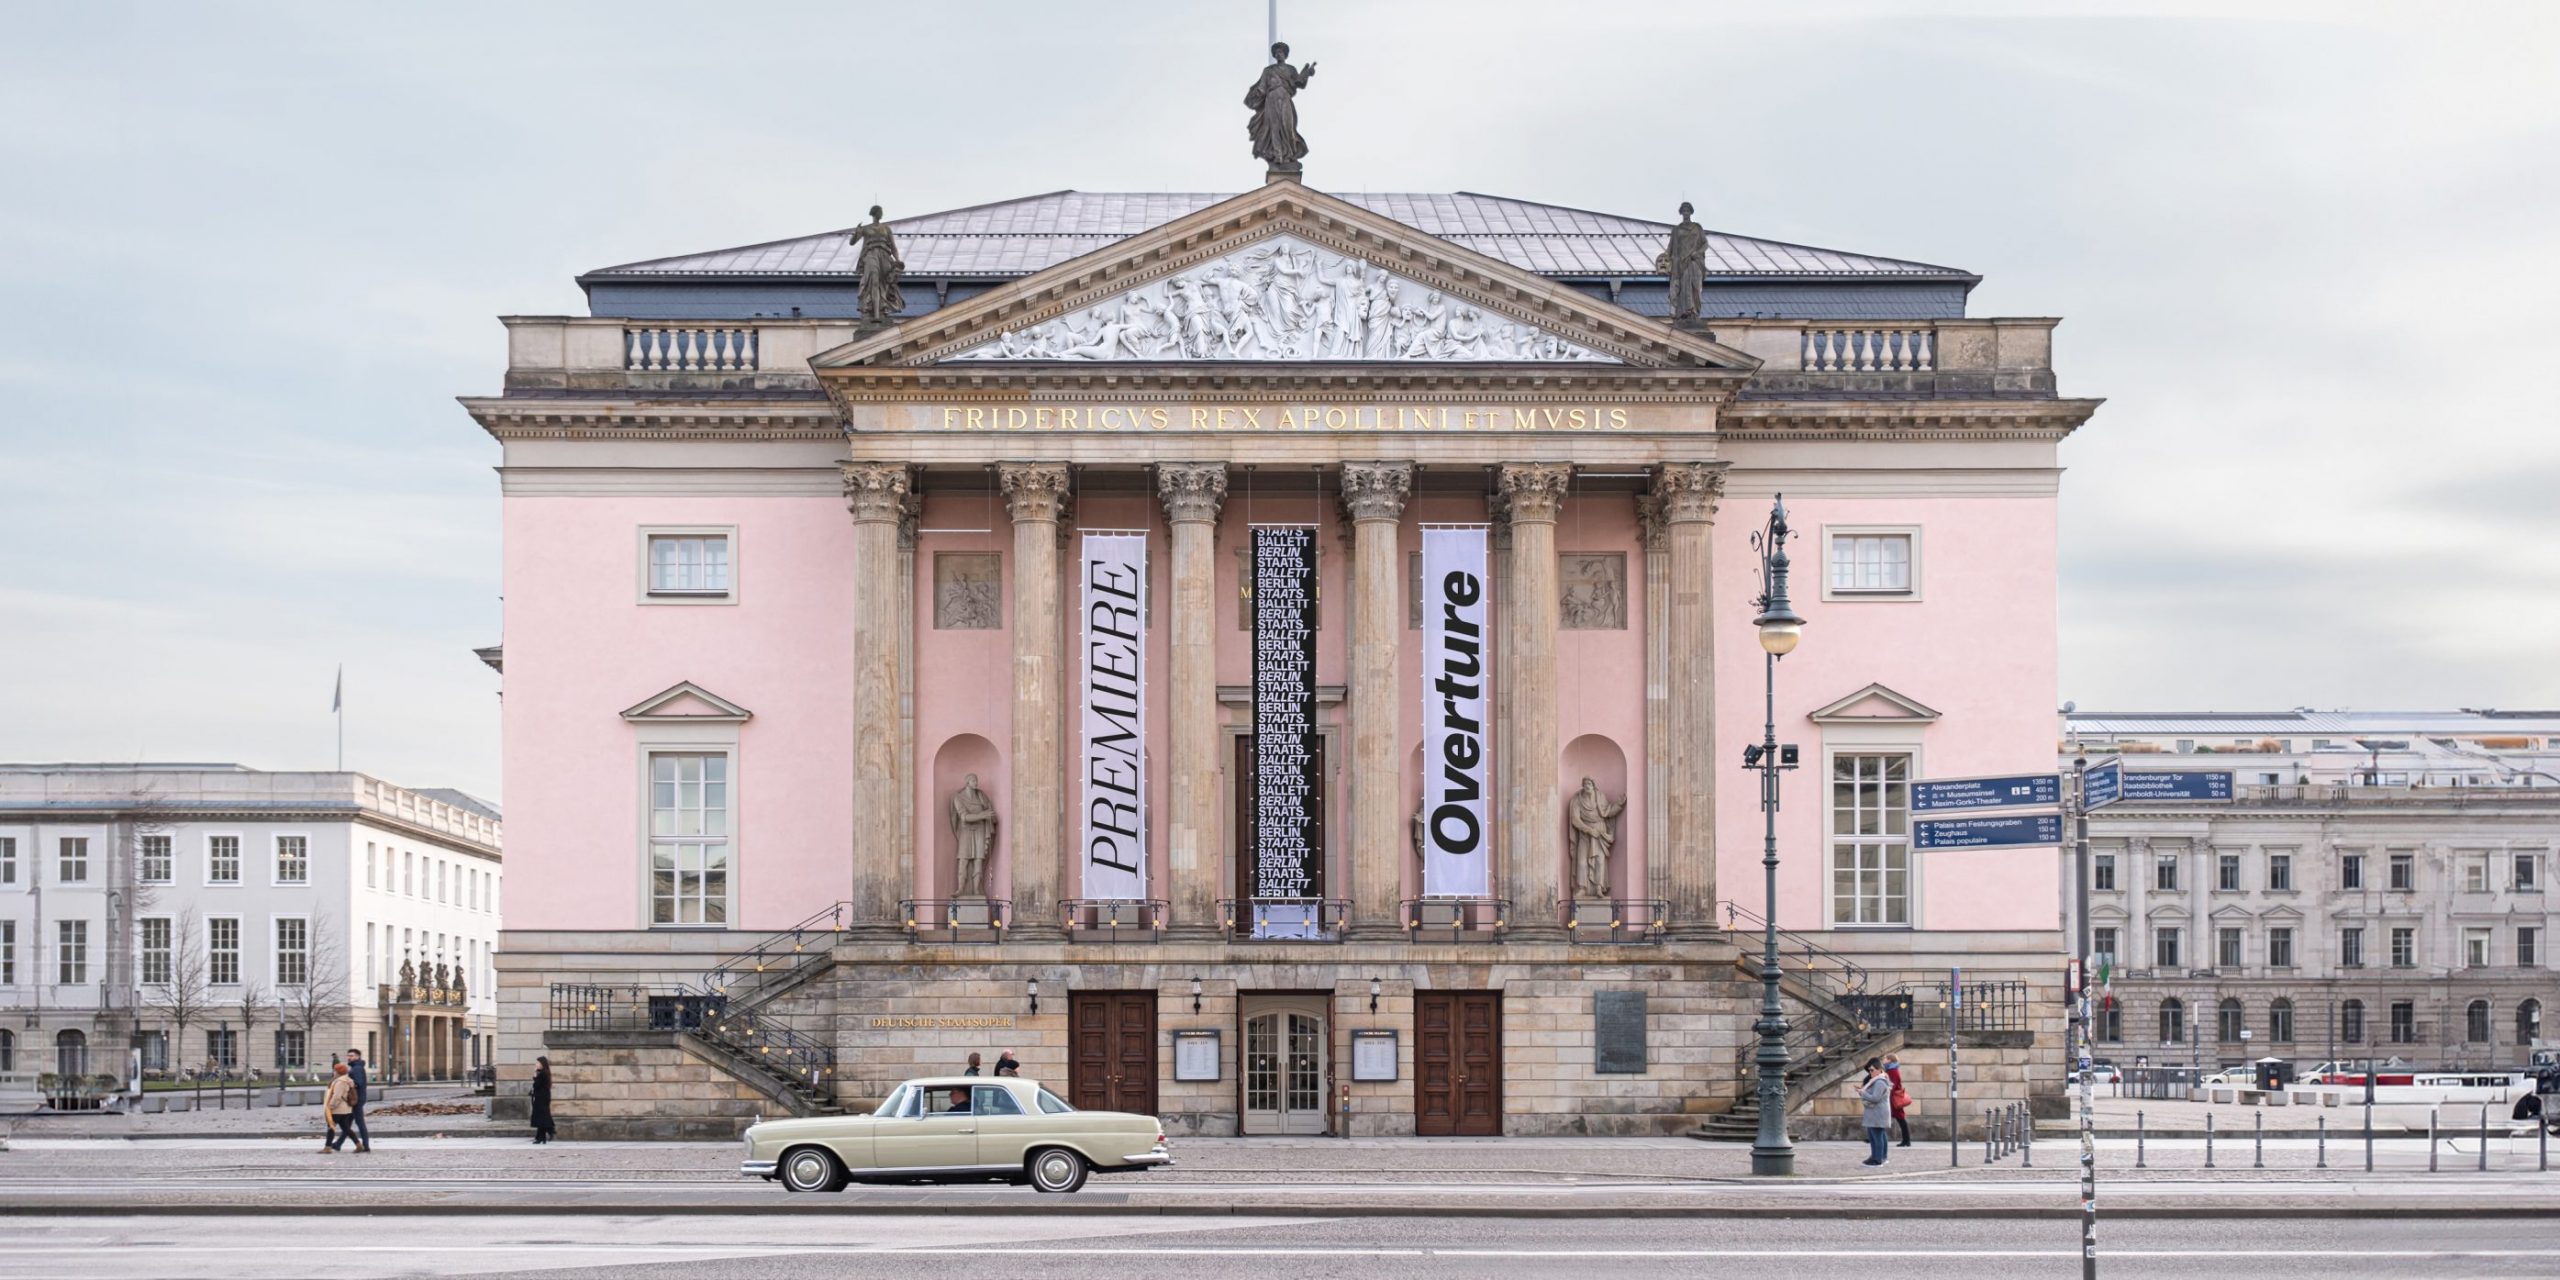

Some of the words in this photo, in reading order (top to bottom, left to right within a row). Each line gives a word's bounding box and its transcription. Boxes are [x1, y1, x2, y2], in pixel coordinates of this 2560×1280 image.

[943, 408, 1169, 430] FRIDERICVS
[1191, 408, 1261, 430] REX
[1277, 408, 1449, 430] APOLLINI
[1464, 412, 1500, 430] ET
[1514, 408, 1628, 430] MVSIS
[1258, 529, 1304, 537] STAATS
[1258, 536, 1309, 547] BALLETT
[1258, 546, 1300, 557] BERLIN
[1258, 557, 1303, 568] STAATS
[1258, 567, 1310, 578] BALLETT
[1258, 577, 1300, 589] BERLIN
[1258, 588, 1304, 599] STAATS
[1258, 598, 1309, 609] BALLETT
[1258, 608, 1301, 619] BERLIN
[1258, 619, 1303, 630] STAATS
[1258, 629, 1310, 640] BALLETT
[1258, 639, 1300, 651] BERLIN
[1258, 650, 1304, 661] STAATS
[1259, 660, 1309, 672] BALLETT
[1258, 671, 1301, 682] BERLIN
[1258, 681, 1304, 692] STAATS
[1258, 691, 1310, 703] BALLETT
[1259, 702, 1300, 713] BERLIN
[1430, 570, 1480, 855] Overture
[1090, 559, 1139, 879] PREMIERE
[1258, 712, 1304, 724] STAATS
[1259, 723, 1309, 734] BALLETT
[1258, 733, 1301, 745] BERLIN
[1259, 744, 1304, 755] STAATS
[1259, 754, 1311, 765] BALLETT
[1259, 765, 1300, 775] BERLIN
[1259, 774, 1305, 786] STAATS
[1259, 785, 1310, 796] BALLETT
[1931, 782, 1981, 791] Alexanderplatz
[1946, 789, 1995, 798] Museumsinsel
[1259, 795, 1301, 807] BERLIN
[1931, 798, 2002, 807] Maxim-Gorki-Theater
[1259, 806, 1304, 817] STAATS
[1259, 816, 1311, 827] BALLETT
[1968, 819, 2023, 828] Festungsgraben
[1259, 826, 1300, 838] BERLIN
[1934, 830, 1968, 838] Zeughaus
[1259, 837, 1305, 848] STAATS
[1956, 837, 1988, 846] populaire
[1259, 847, 1310, 858] BALLETT
[1259, 858, 1301, 868] BERLIN
[1259, 867, 1304, 879] STAATS
[1259, 878, 1311, 889] BALLETT
[871, 1017, 936, 1028] DEUTSCHE
[938, 1017, 1012, 1028] STAATSOPER
